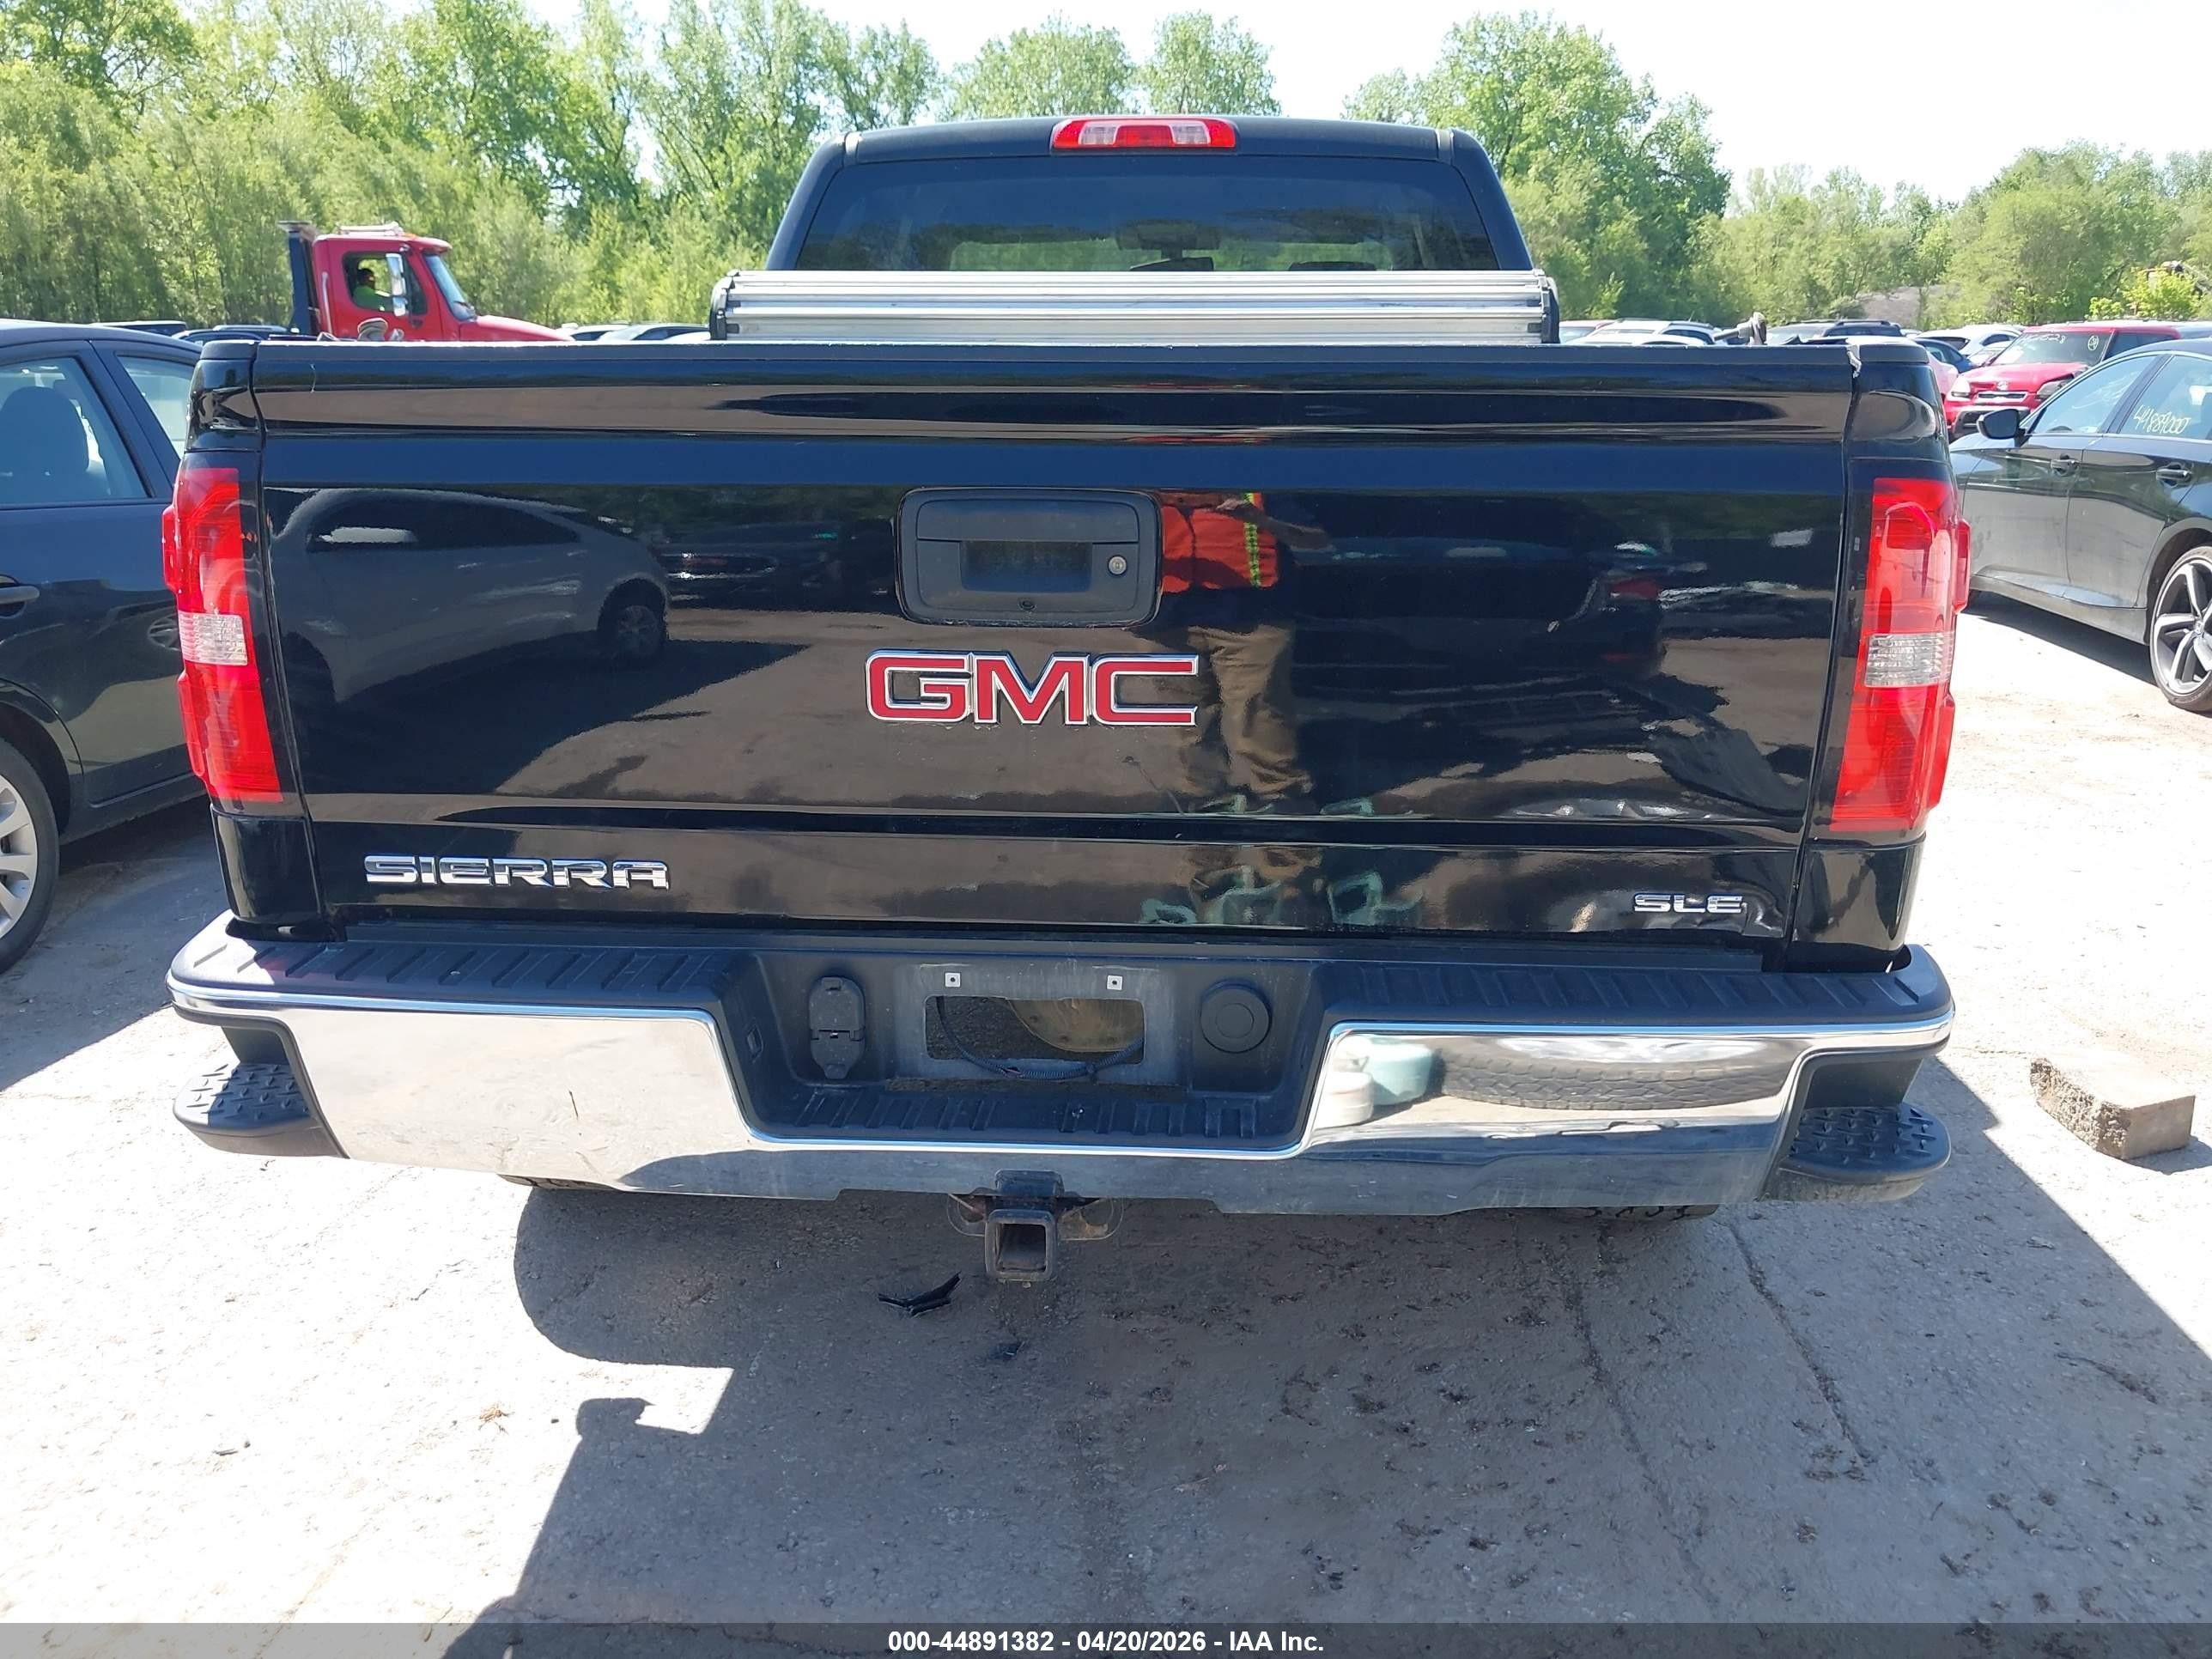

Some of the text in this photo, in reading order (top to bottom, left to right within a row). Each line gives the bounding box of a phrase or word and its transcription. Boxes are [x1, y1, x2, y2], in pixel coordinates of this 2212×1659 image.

[866, 649, 1199, 726] GMC
[364, 855, 670, 890] SIERRA
[1634, 894, 1743, 914] SLE
